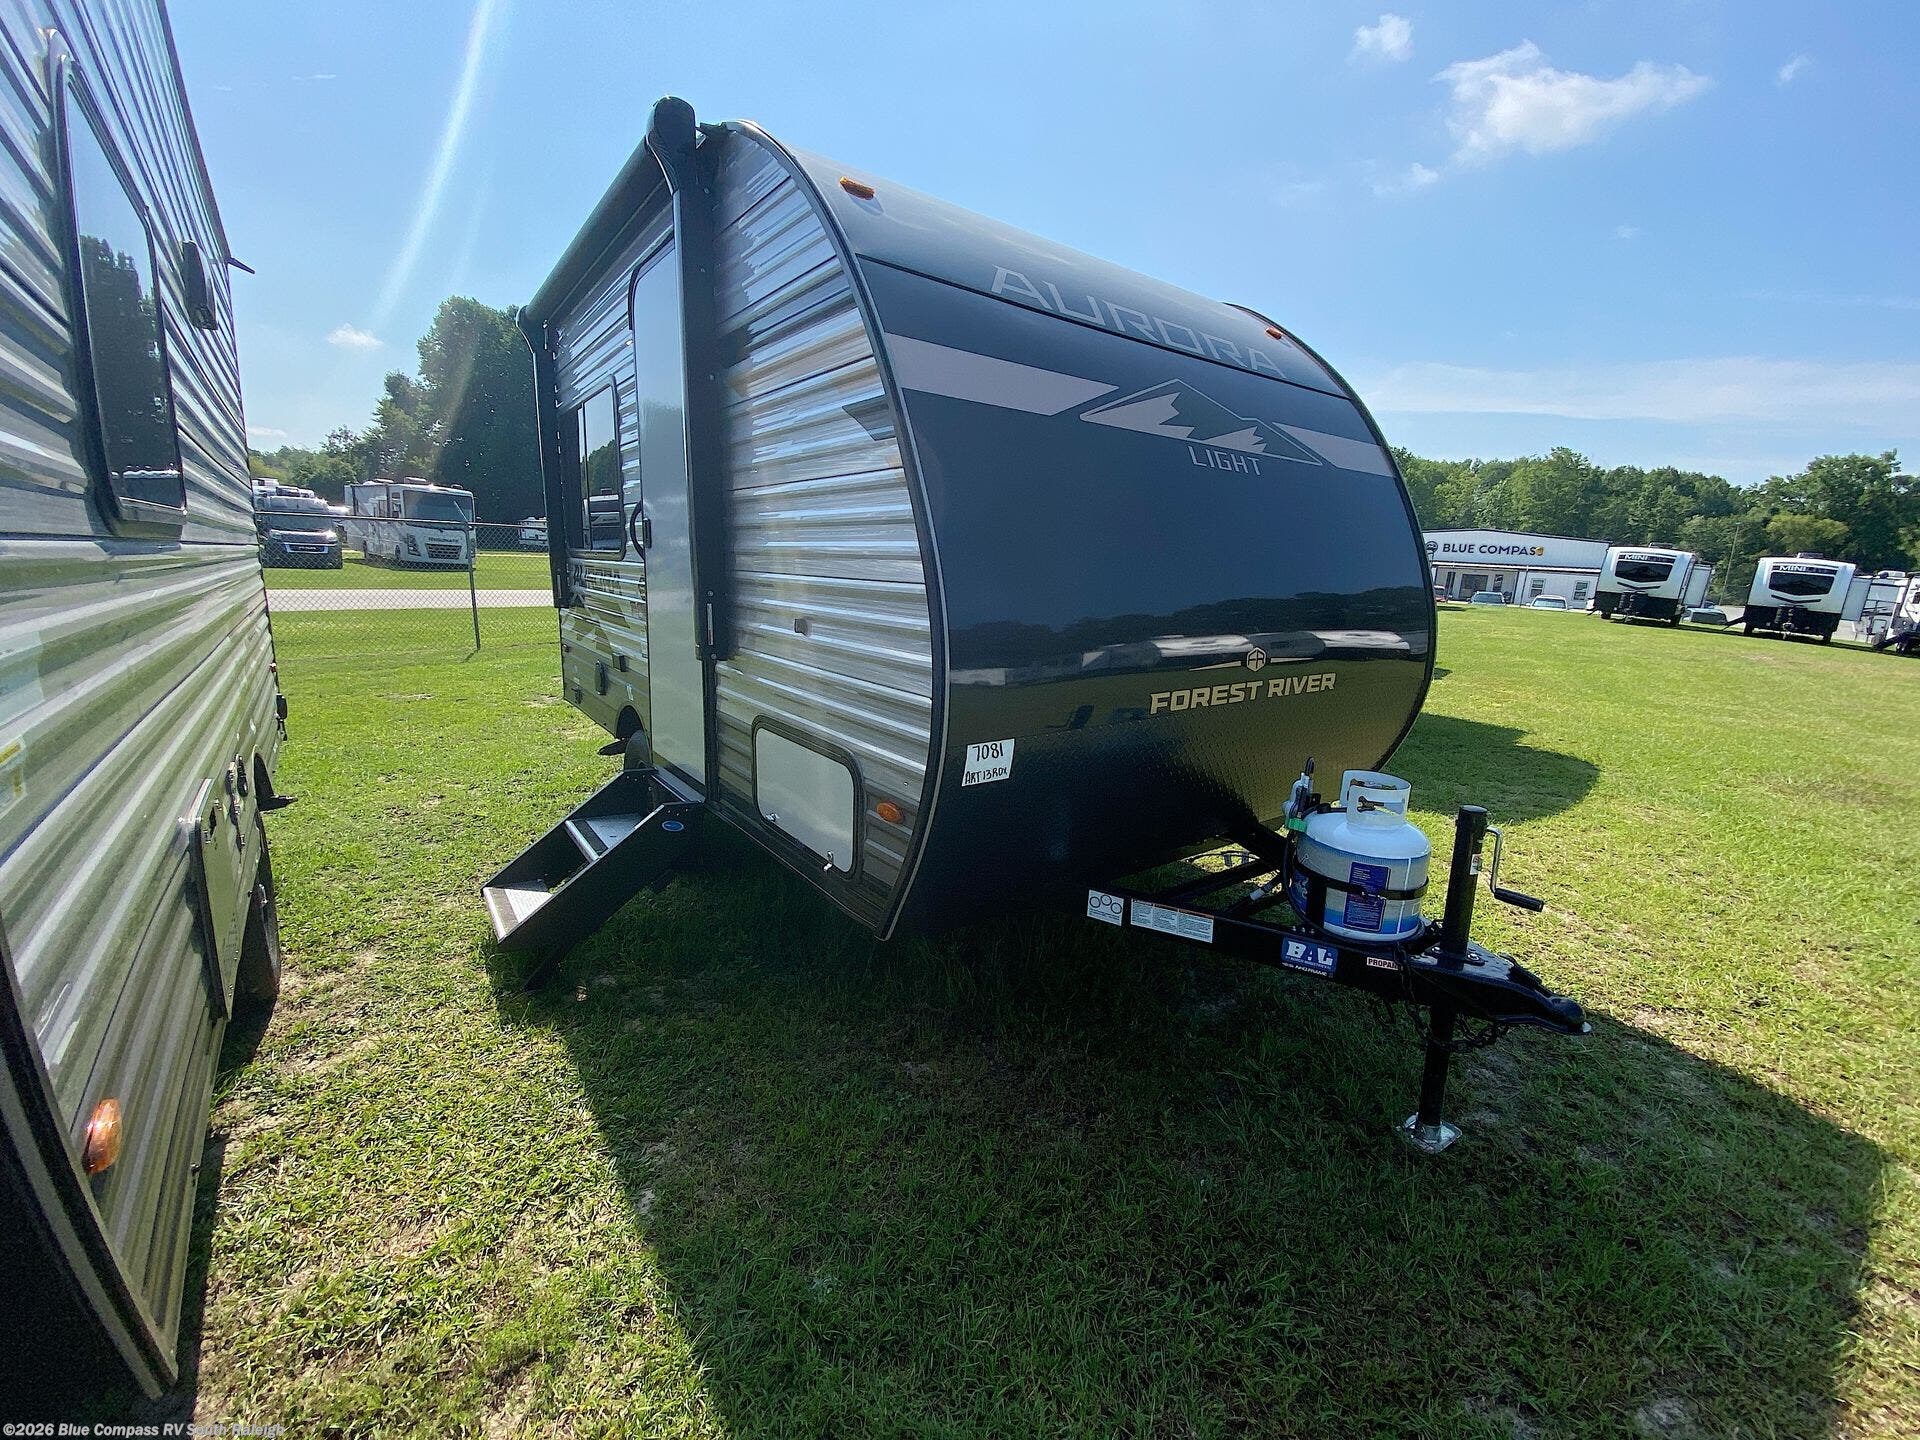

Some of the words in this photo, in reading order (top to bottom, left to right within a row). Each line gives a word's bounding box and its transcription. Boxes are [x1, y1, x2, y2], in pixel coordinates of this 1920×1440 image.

[990, 264, 1286, 379] AURORA
[1186, 445, 1263, 477] LIGHT
[1442, 543, 1475, 554] BLUE
[1624, 553, 1649, 561] MINI
[1779, 564, 1807, 572] MINI
[1150, 680, 1264, 715] FOREST
[1267, 672, 1337, 698] RIVER
[972, 742, 1004, 762] 7081
[1286, 940, 1334, 966] BAL
[1367, 958, 1399, 970] PROPAN
